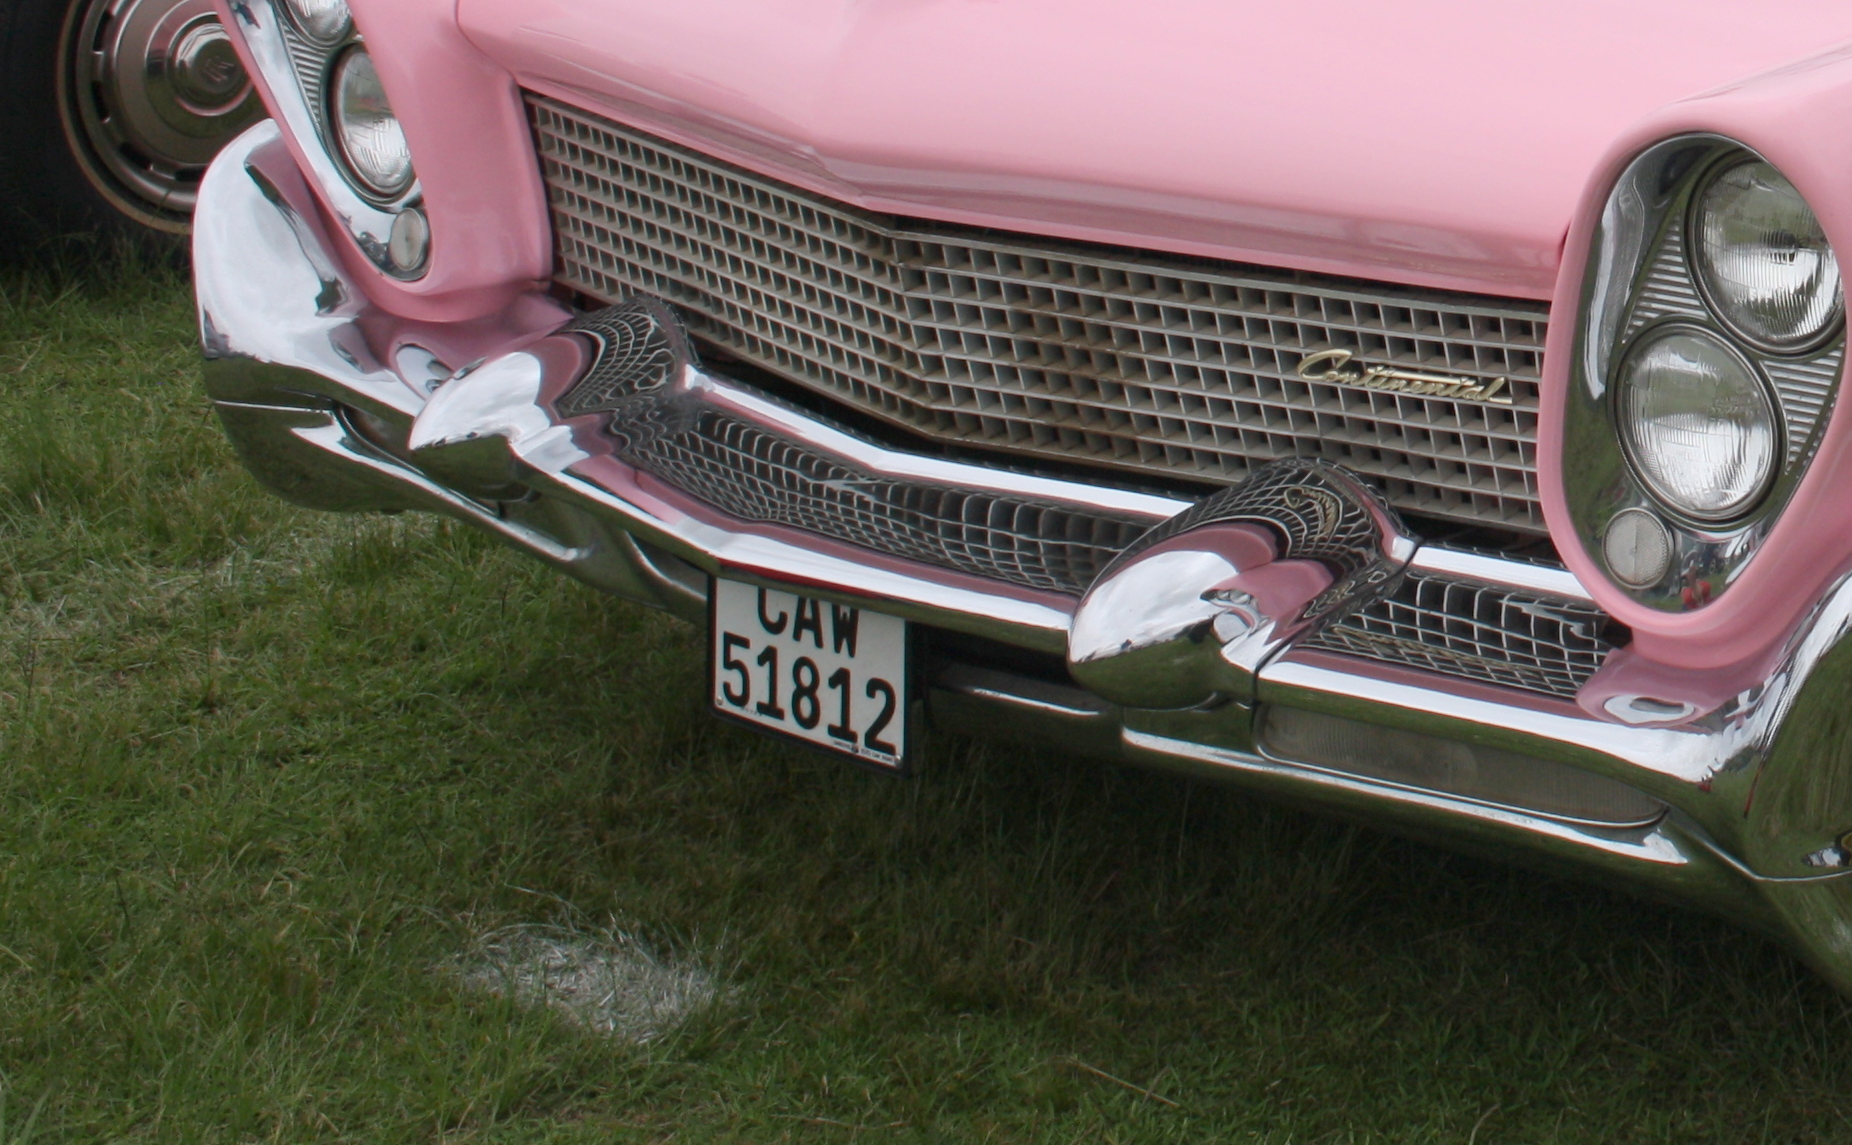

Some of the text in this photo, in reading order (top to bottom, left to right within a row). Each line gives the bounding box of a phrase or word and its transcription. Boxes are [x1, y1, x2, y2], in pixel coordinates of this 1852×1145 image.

[1297, 348, 1513, 404] Continental
[757, 586, 860, 658] CAW
[722, 630, 897, 756] 51812
